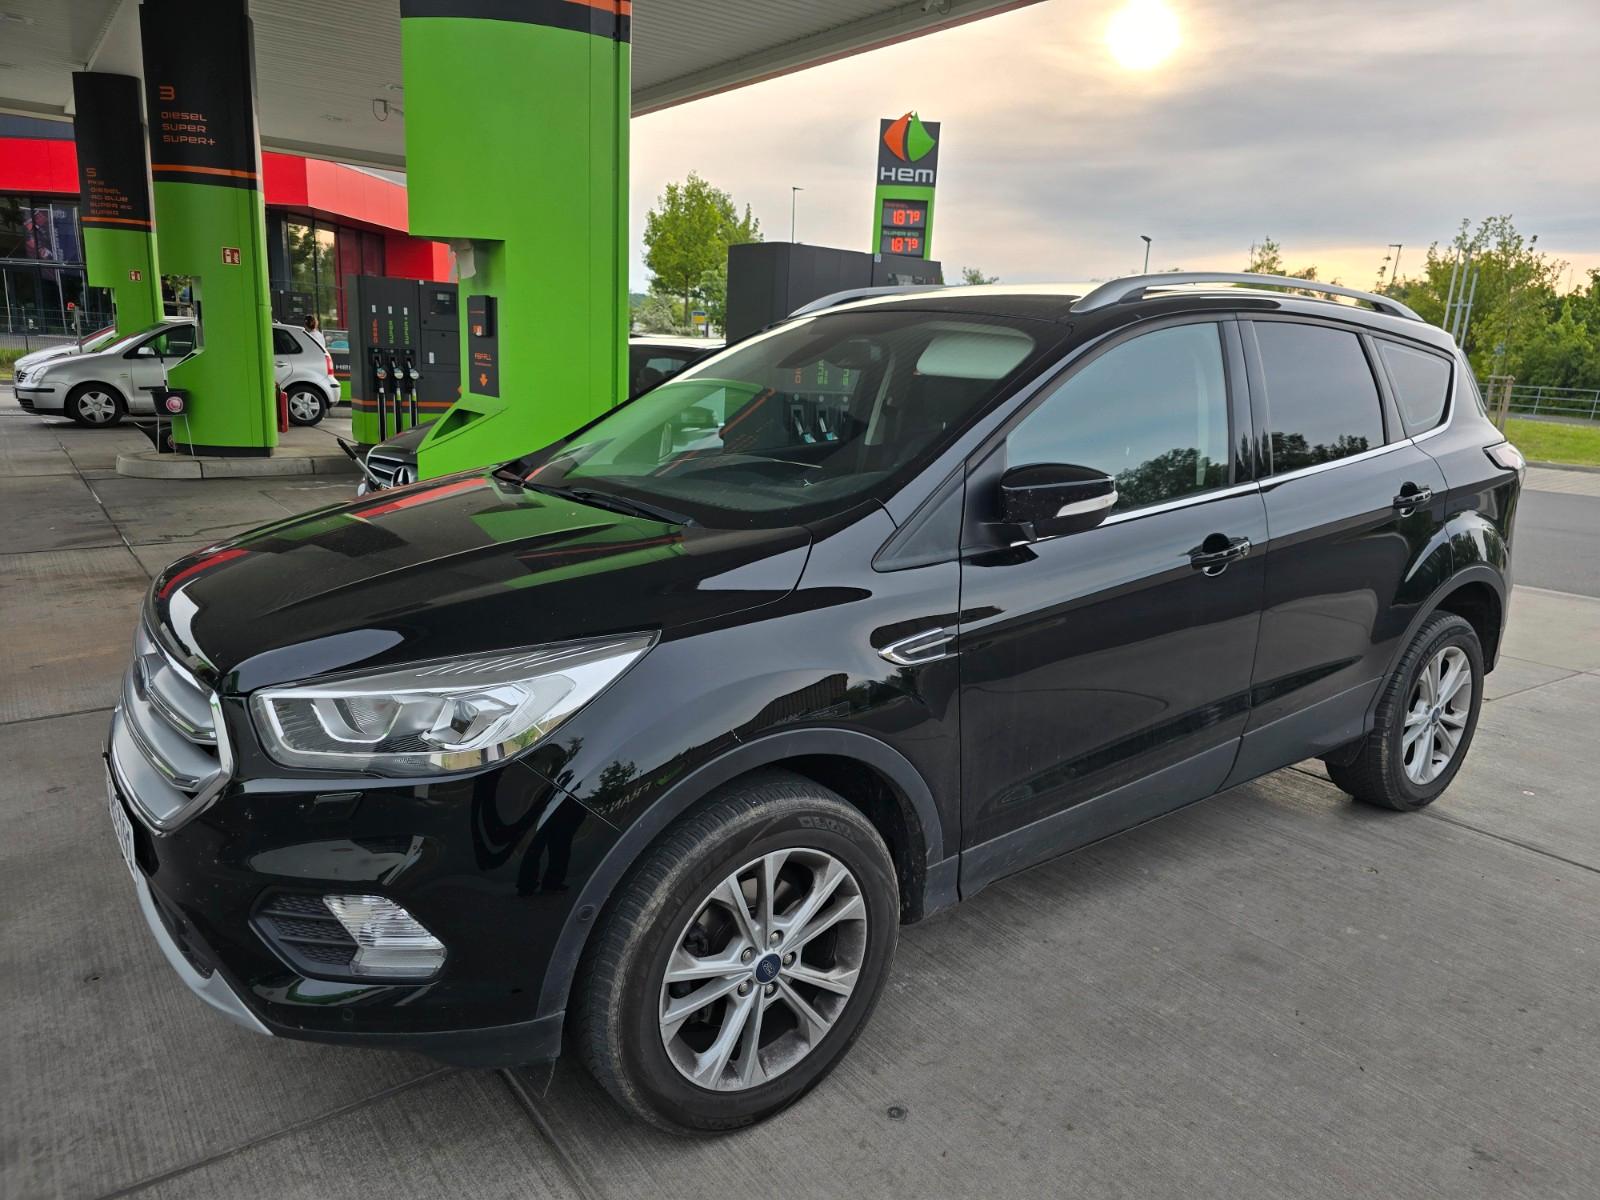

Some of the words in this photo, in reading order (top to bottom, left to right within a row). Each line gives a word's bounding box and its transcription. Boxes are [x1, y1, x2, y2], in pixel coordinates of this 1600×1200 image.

[159, 85, 176, 100] 3
[161, 112, 207, 121] DIESEL
[162, 123, 206, 132] SUPER
[163, 135, 216, 146] SUPER+
[881, 167, 933, 183] HEM
